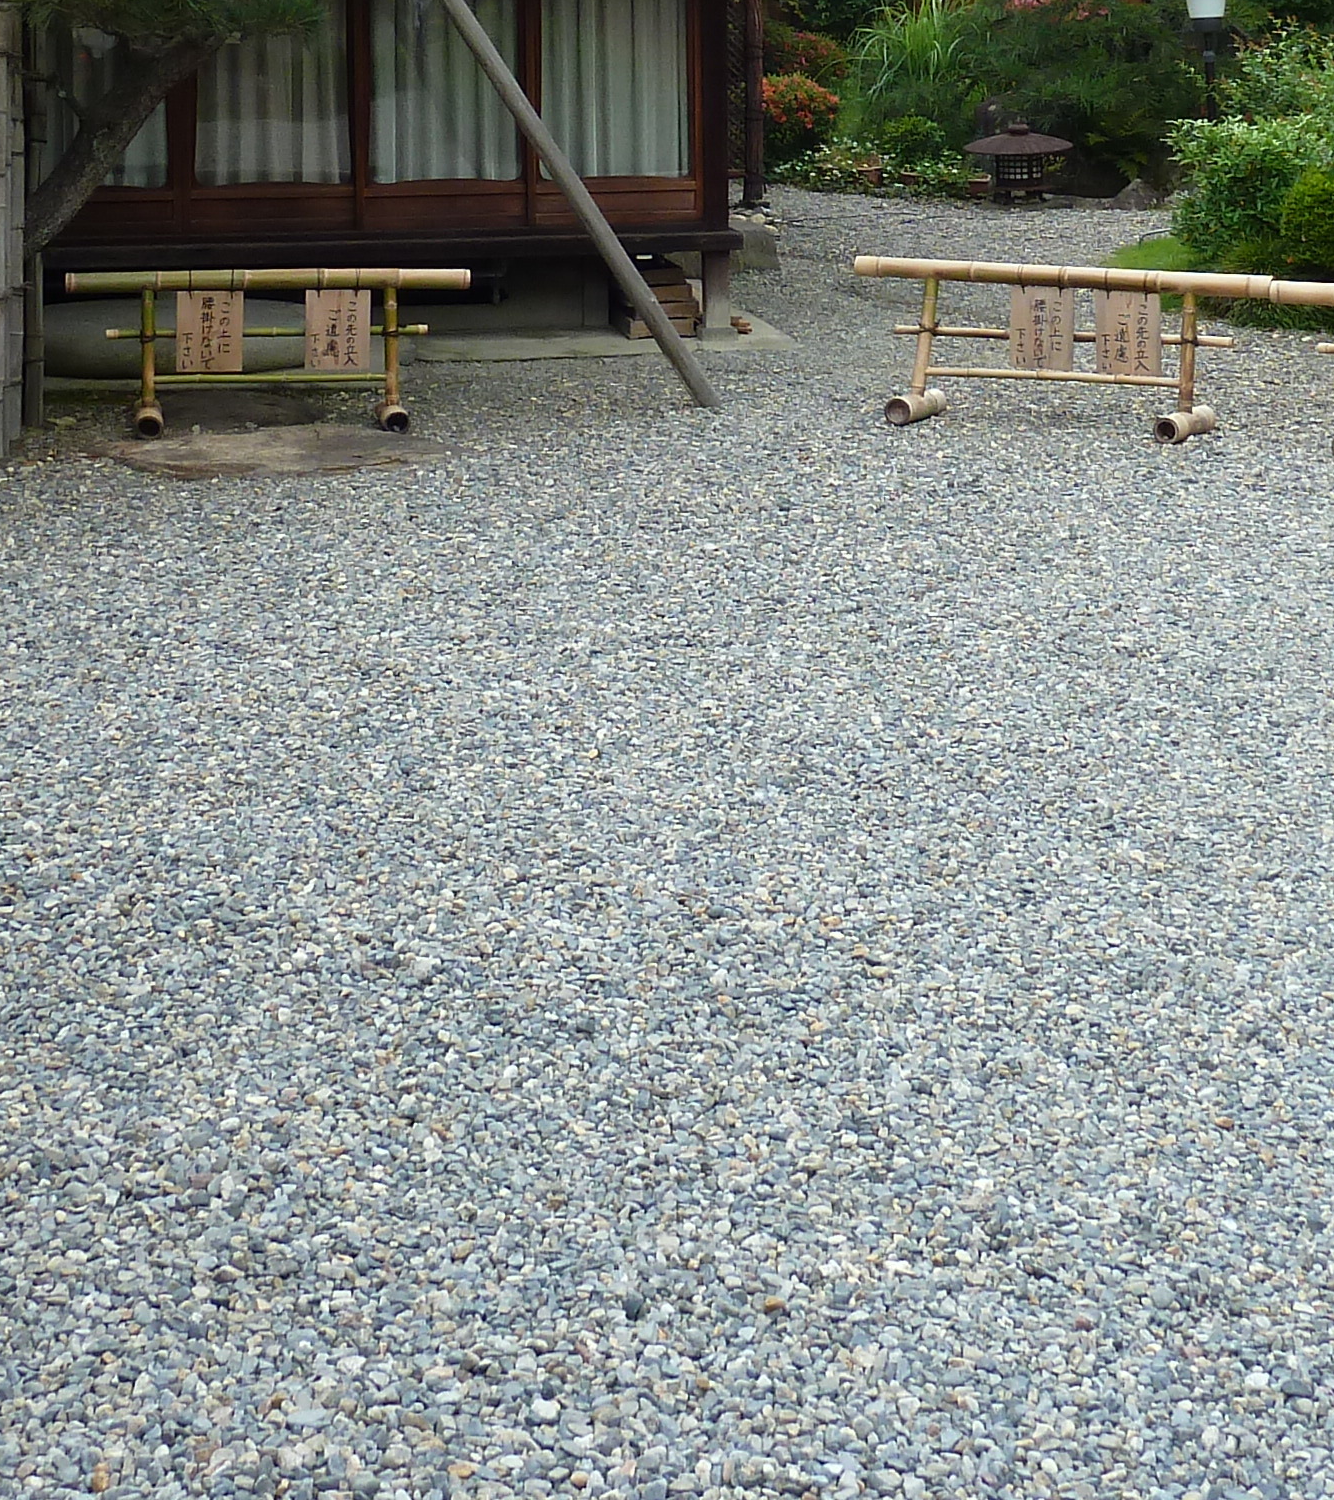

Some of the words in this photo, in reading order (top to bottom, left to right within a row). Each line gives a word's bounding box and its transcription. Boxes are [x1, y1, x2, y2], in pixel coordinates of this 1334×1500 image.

[181, 332, 194, 369] 下さい
[217, 301, 232, 354] この上に
[1048, 300, 1064, 352] この上に
